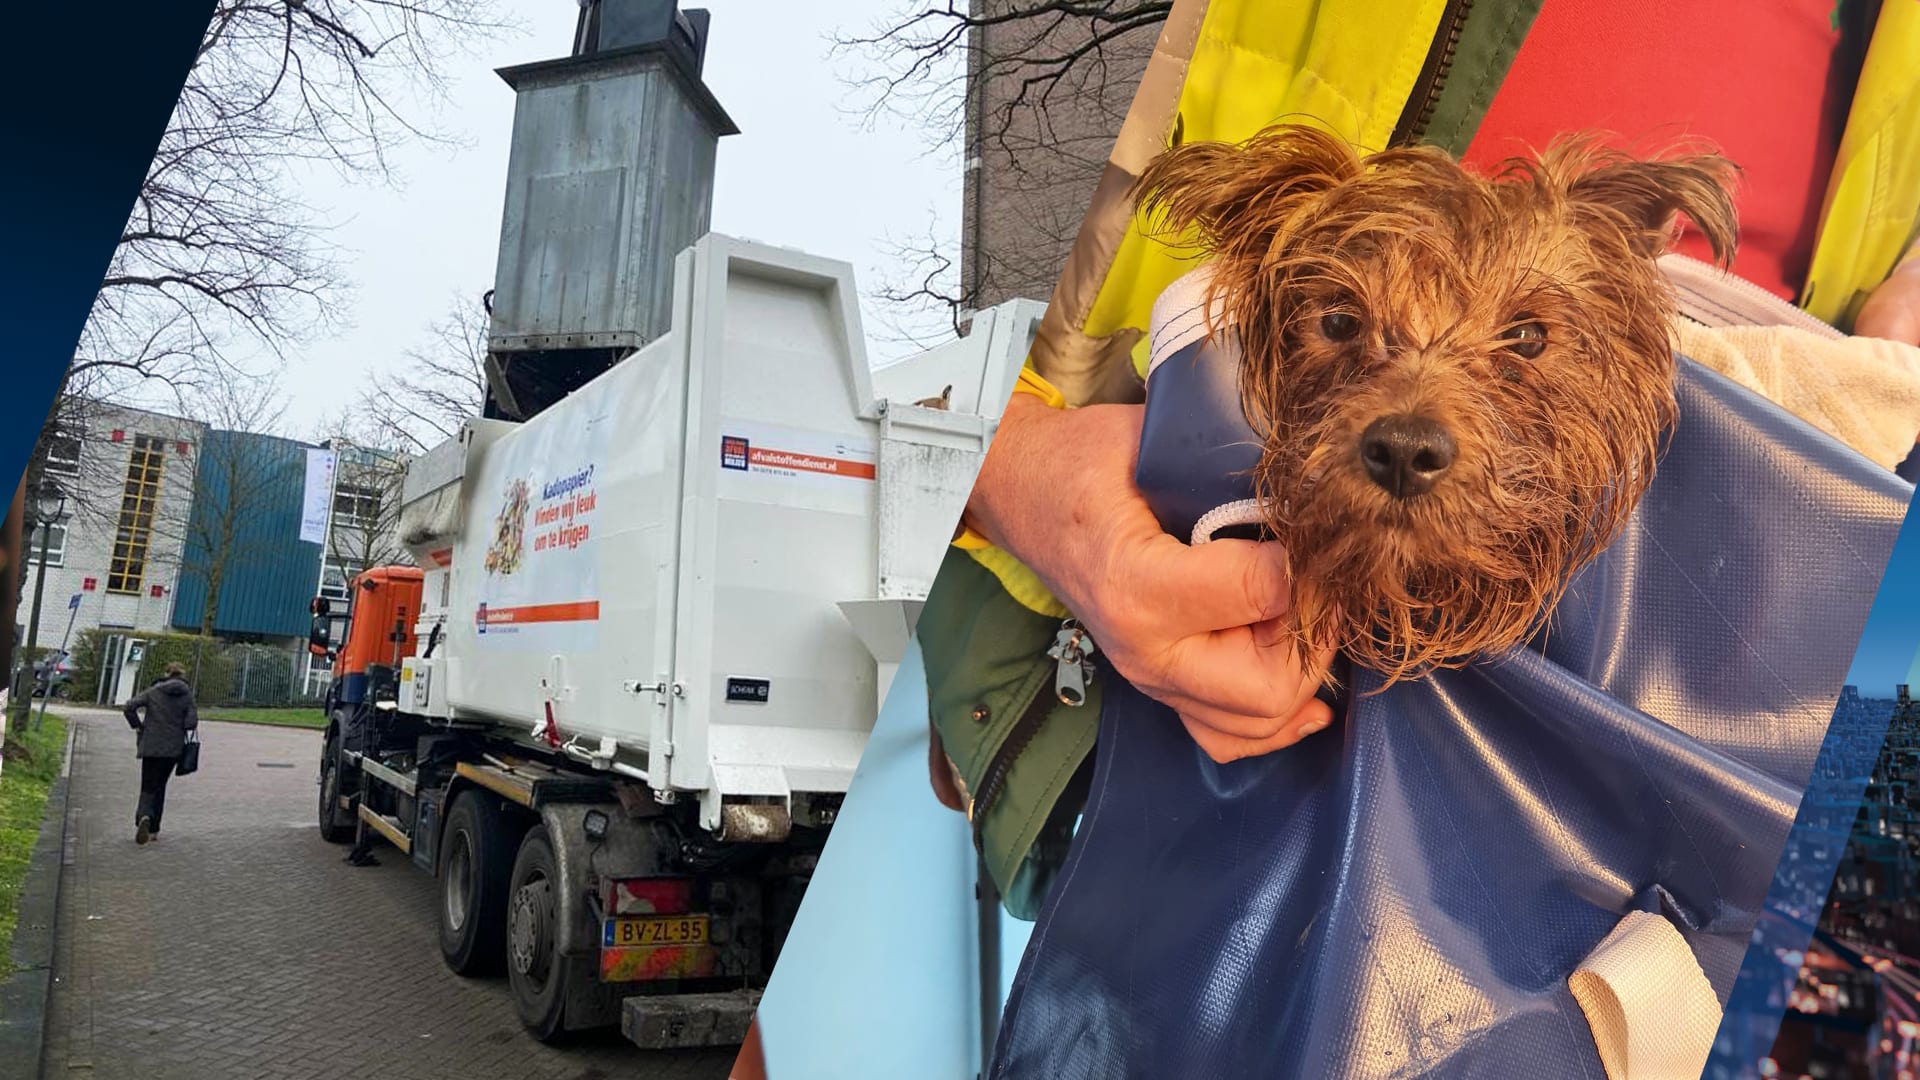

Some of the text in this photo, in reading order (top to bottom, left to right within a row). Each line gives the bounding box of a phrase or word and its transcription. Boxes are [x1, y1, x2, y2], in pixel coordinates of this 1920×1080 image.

[751, 450, 838, 472] afvalstoffendienst.nl
[543, 464, 594, 501] Kadopapier?
[562, 495, 575, 522] wij
[577, 488, 596, 515] leuk
[534, 522, 589, 551] om te krijgen
[622, 921, 702, 942] BV-ZL-95
